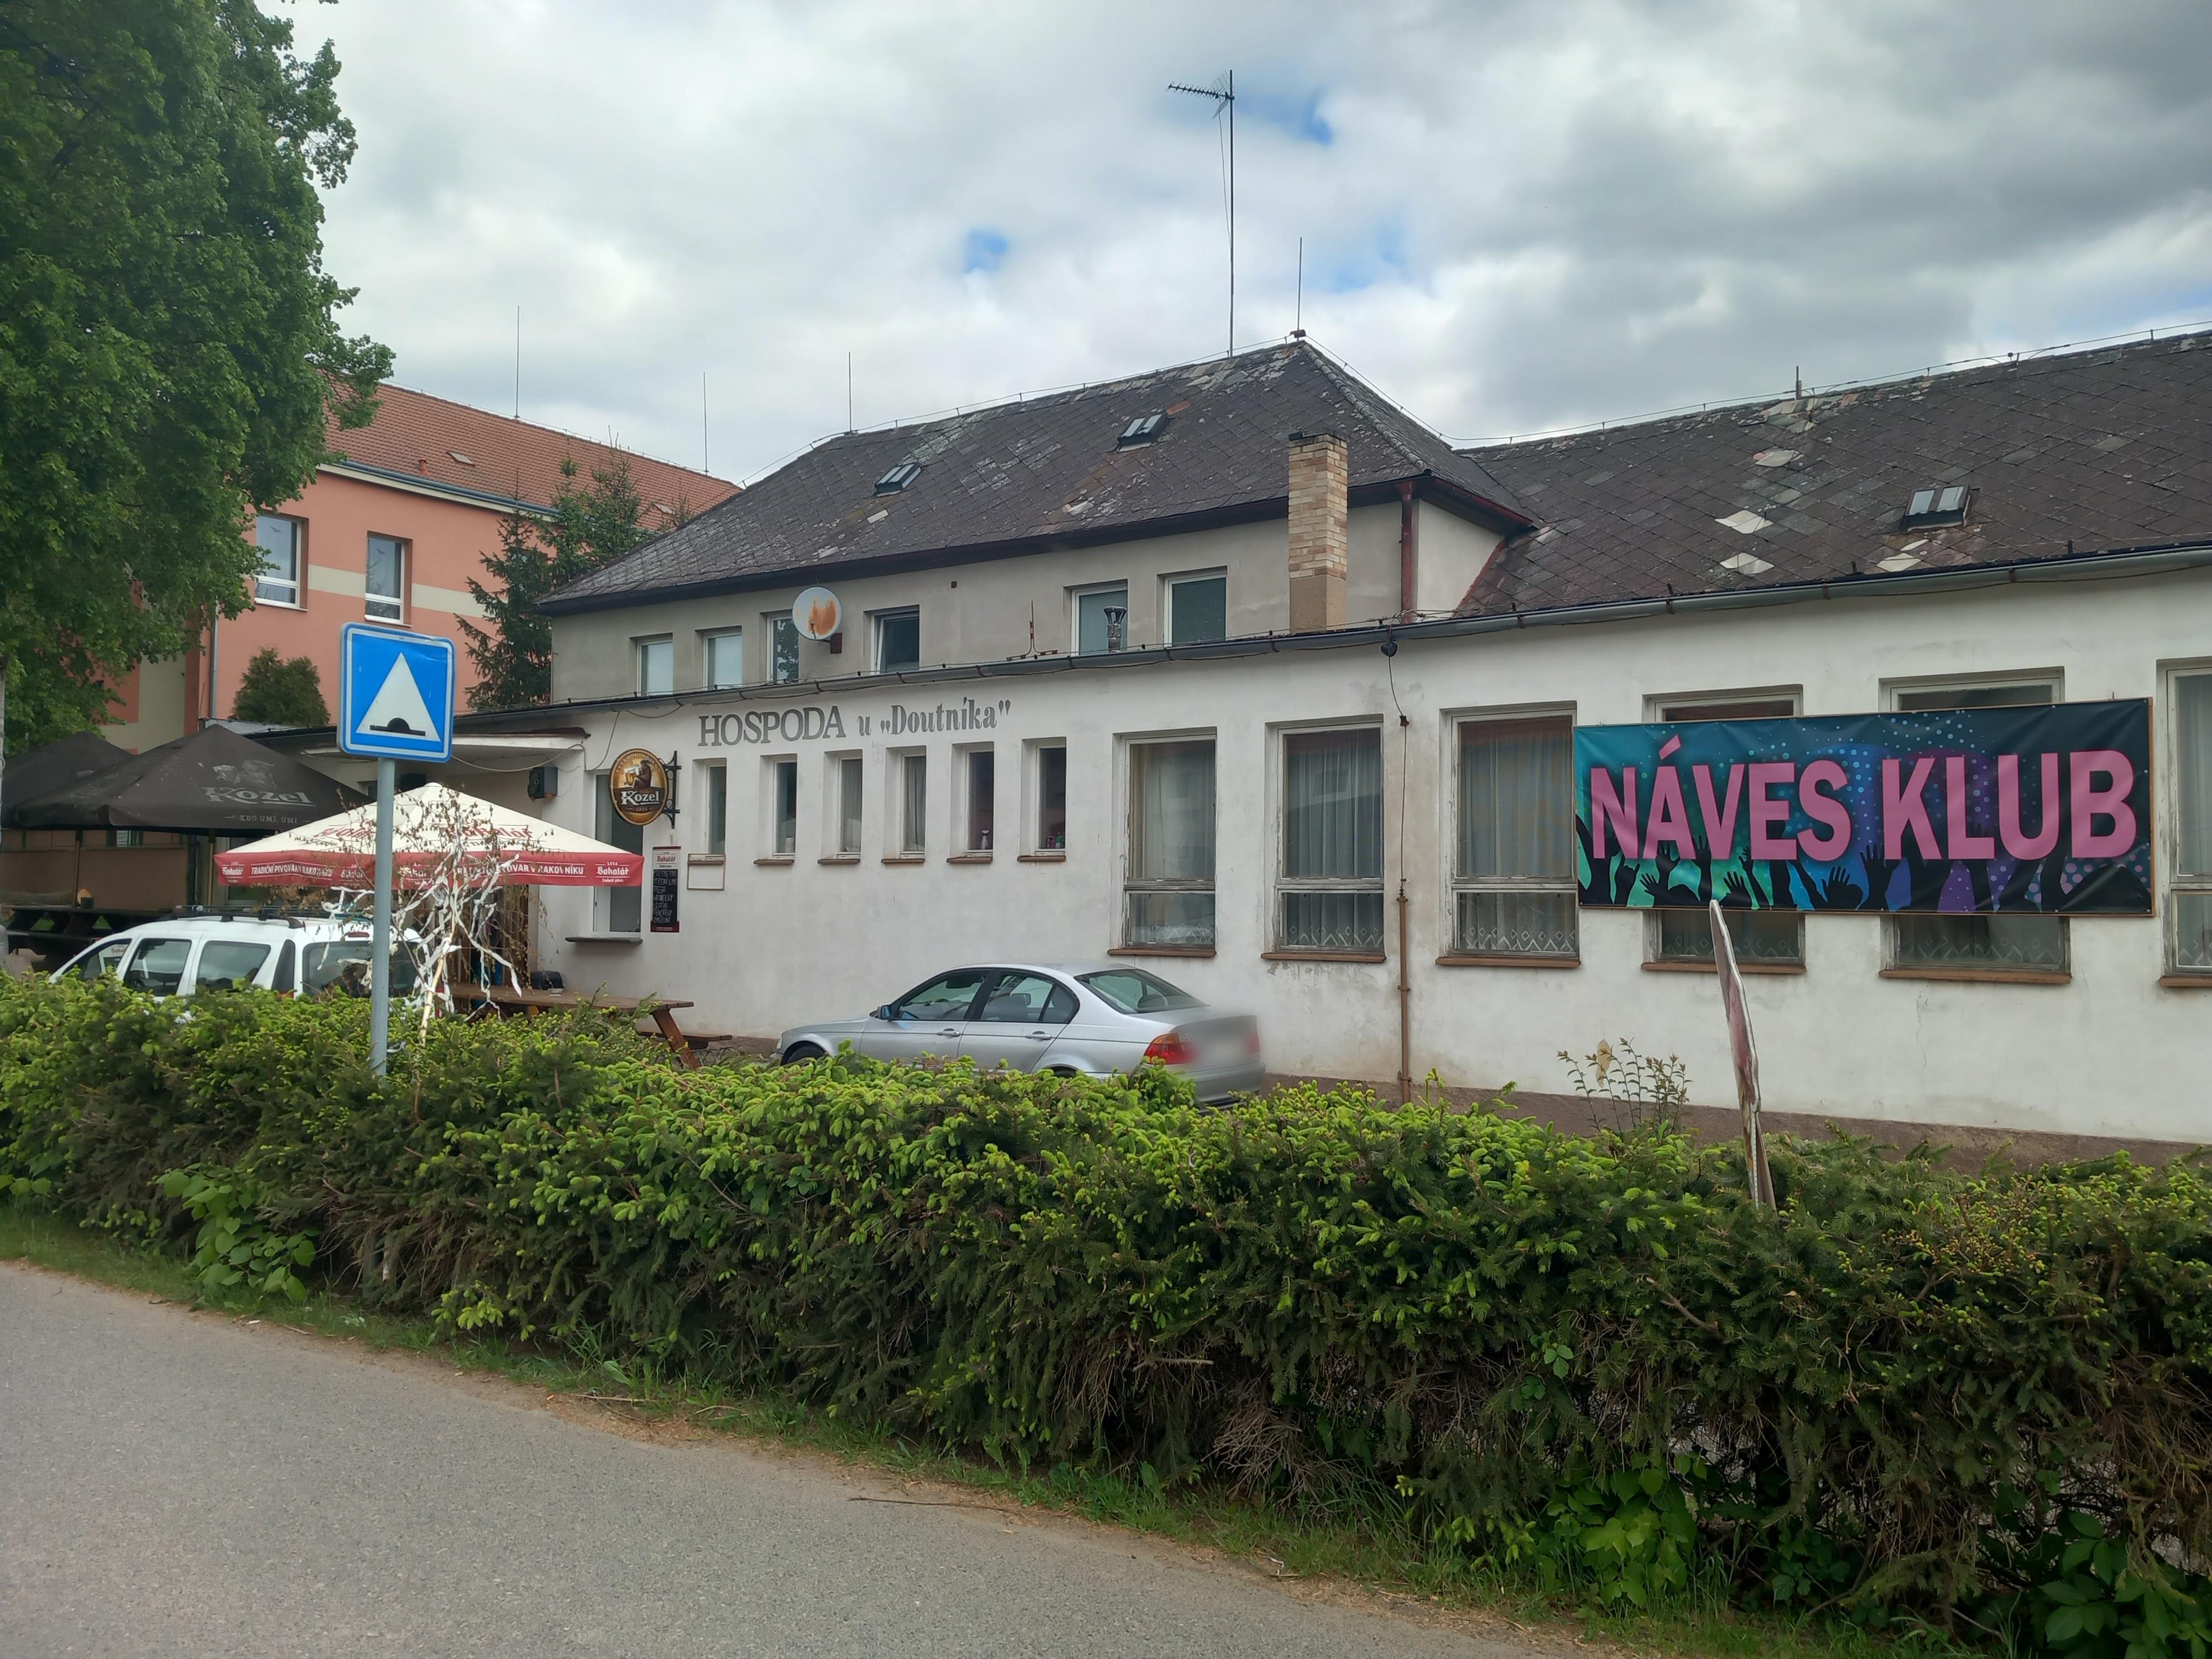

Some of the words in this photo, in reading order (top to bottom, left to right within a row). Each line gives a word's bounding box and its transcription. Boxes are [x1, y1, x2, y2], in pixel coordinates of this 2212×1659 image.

[698, 706, 846, 746] HOSPODA
[857, 716, 872, 737] u
[202, 787, 314, 805] Kozel
[620, 790, 659, 806] Kozel
[1590, 734, 1852, 860] NÁVES
[1882, 750, 2137, 860] KLUB
